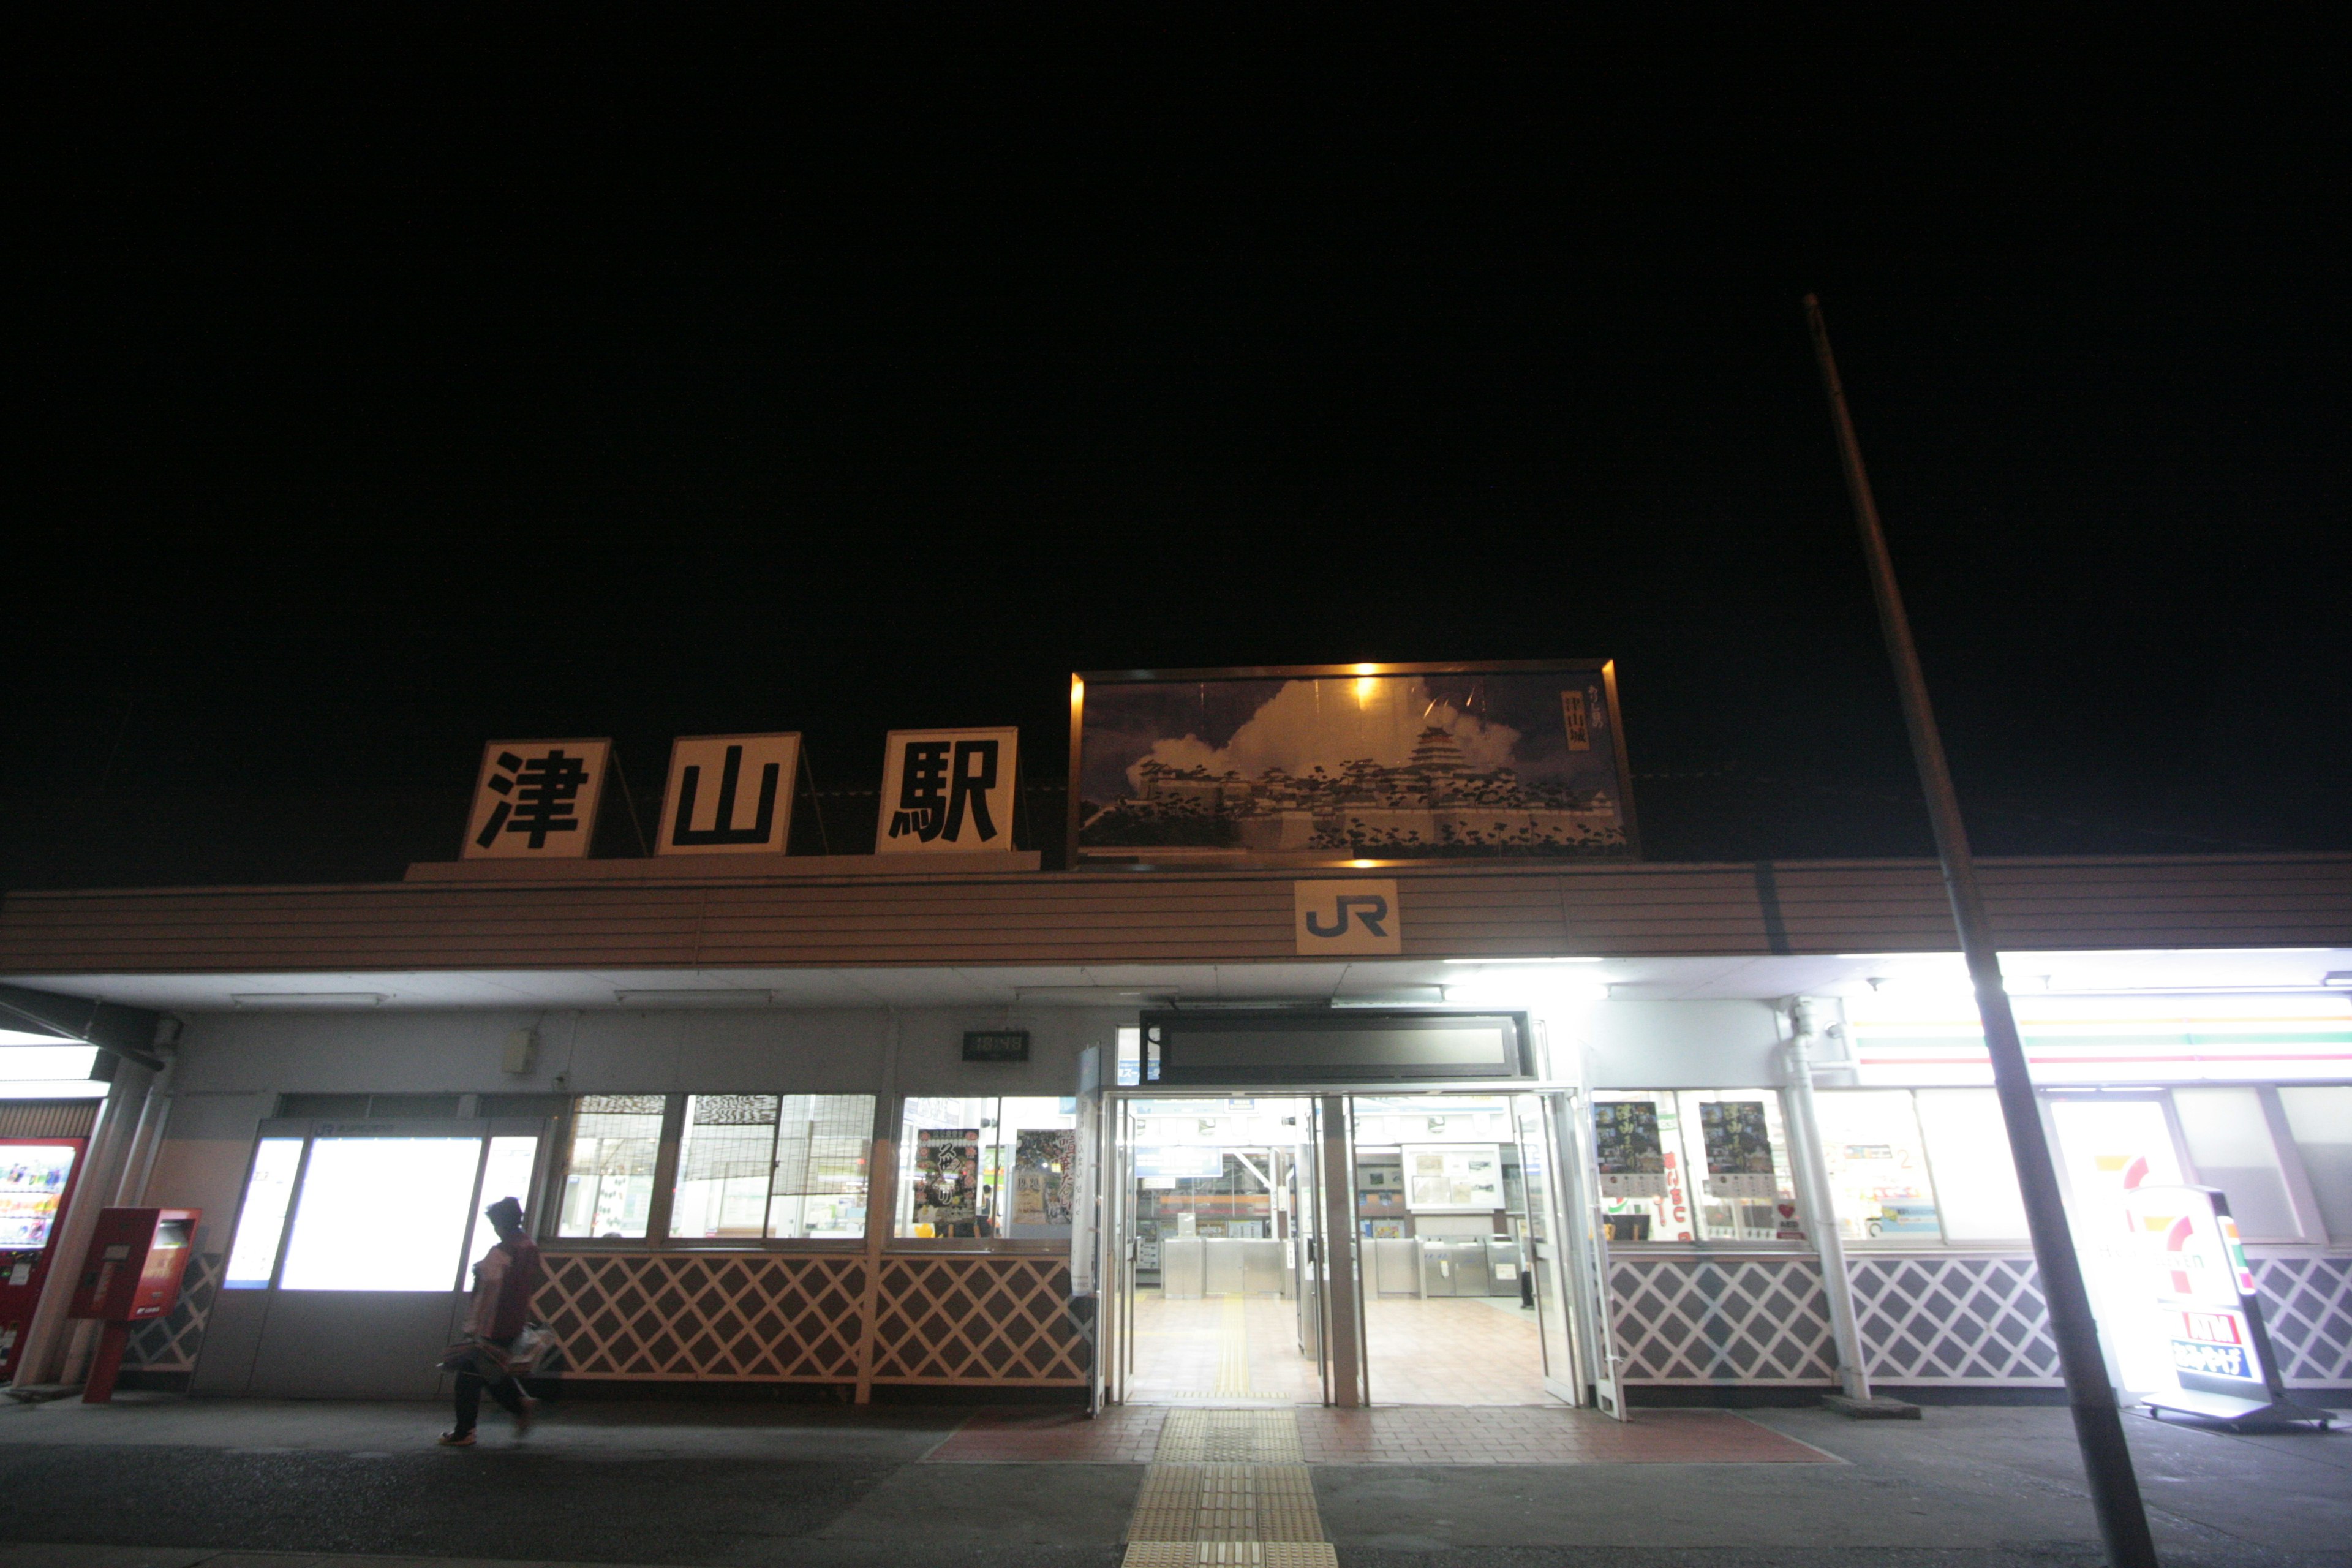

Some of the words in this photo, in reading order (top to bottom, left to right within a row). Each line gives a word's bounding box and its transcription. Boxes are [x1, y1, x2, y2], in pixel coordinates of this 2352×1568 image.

[1565, 697, 1587, 743] 津山城
[475, 739, 1000, 849] 津山駅
[1306, 895, 1389, 938] JR
[2188, 1312, 2236, 1343] ATM
